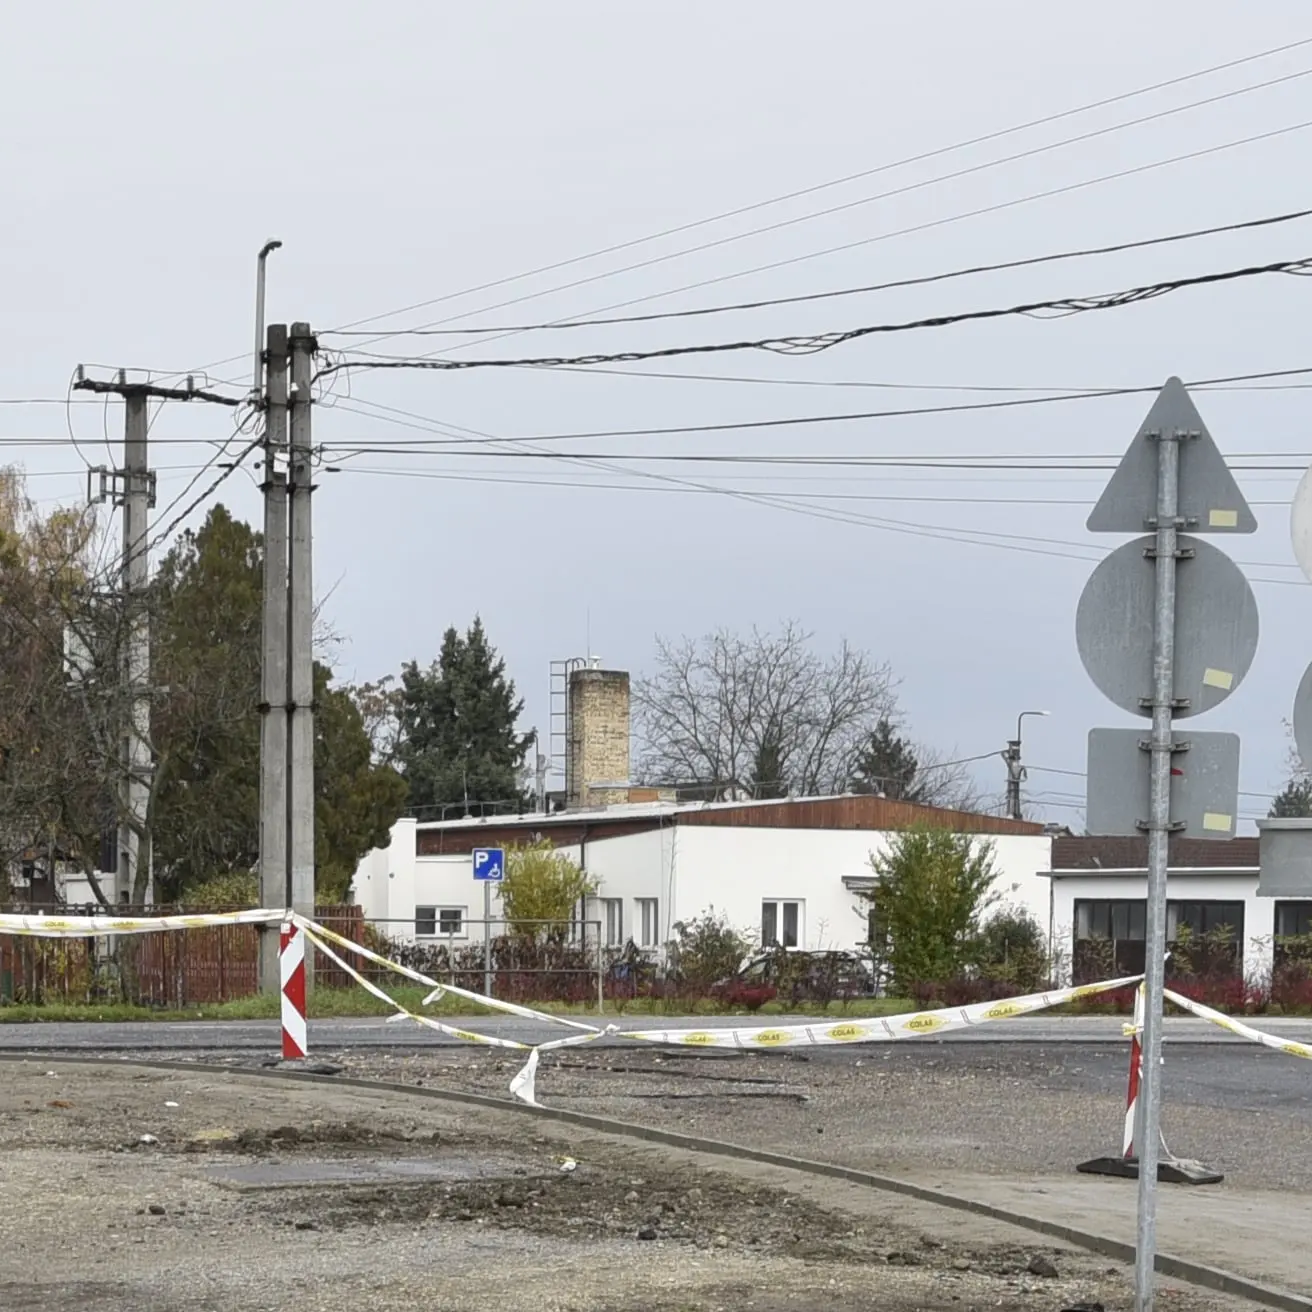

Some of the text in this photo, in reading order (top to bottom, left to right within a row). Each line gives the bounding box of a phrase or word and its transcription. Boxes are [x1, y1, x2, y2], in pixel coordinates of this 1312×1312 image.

[475, 851, 489, 868] P
[989, 1007, 1013, 1017] COLAS
[909, 1019, 933, 1028] COLAS
[832, 1028, 855, 1036] COLAS
